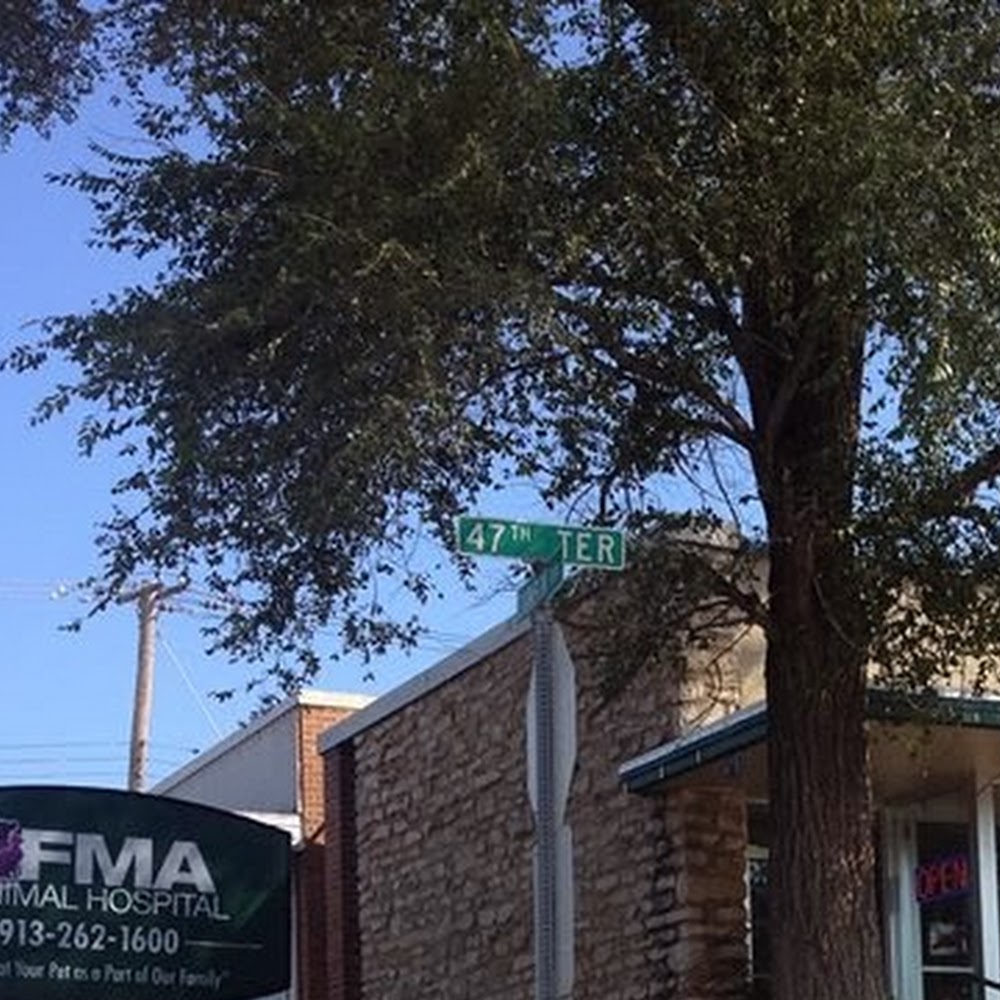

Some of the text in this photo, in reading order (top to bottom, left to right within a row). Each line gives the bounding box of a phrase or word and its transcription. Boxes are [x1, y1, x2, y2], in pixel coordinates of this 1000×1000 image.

[466, 523, 616, 563] 47TH TER
[22, 828, 216, 893] FMA
[915, 856, 969, 901] OPEN
[87, 888, 231, 920] HOSPITAL
[0, 919, 179, 954] 913-262-1600
[48, 961, 71, 979] Pet
[90, 968, 101, 981] a
[104, 964, 132, 982] Part
[151, 966, 176, 985] Our
